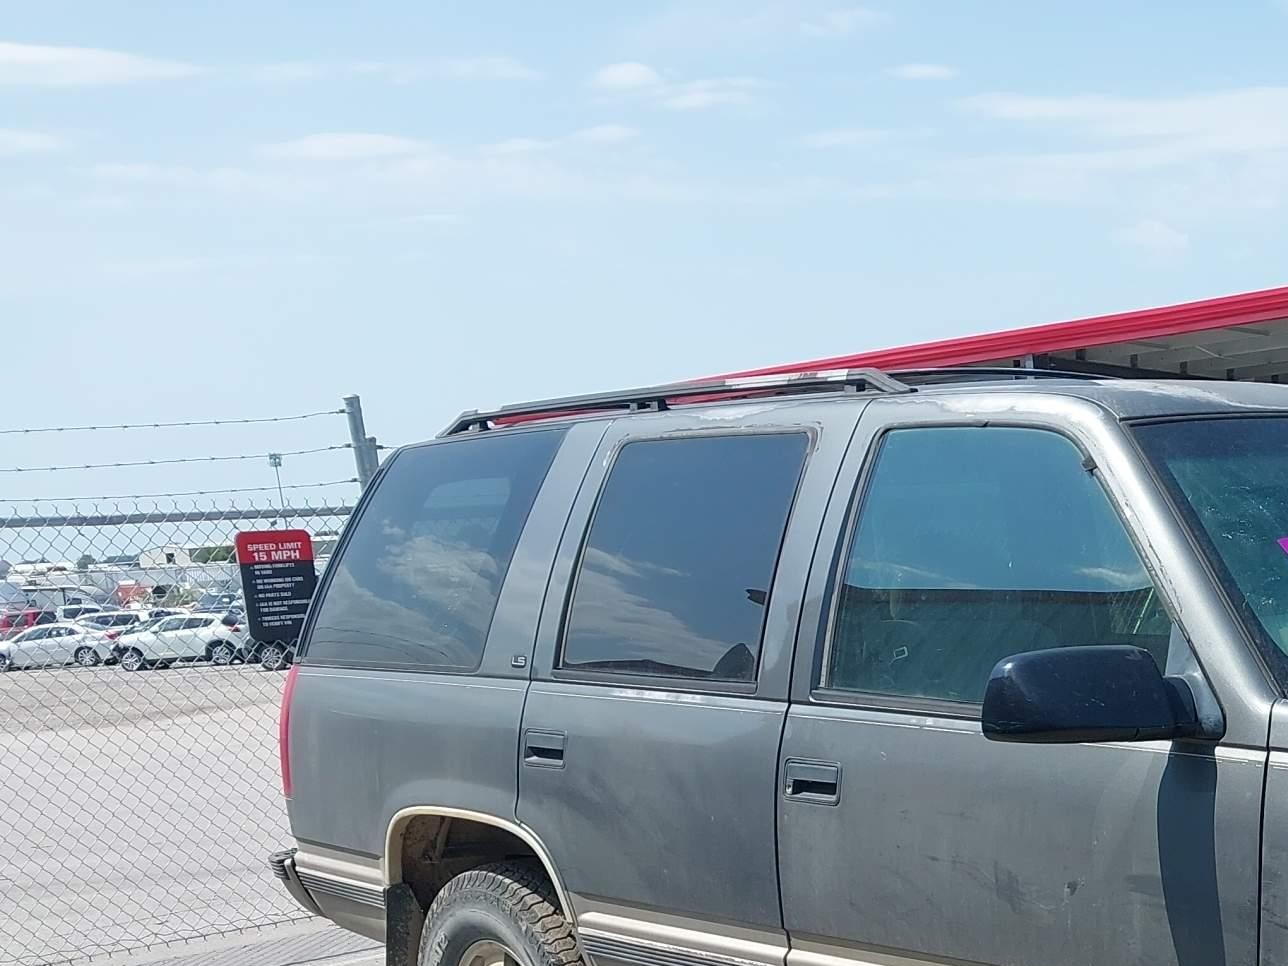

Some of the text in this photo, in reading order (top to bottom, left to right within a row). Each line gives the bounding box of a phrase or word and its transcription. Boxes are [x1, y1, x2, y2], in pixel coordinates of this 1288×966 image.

[247, 541, 302, 551] SPEED LIMIT
[252, 549, 300, 561] 15 MPH
[511, 655, 527, 668] LS
